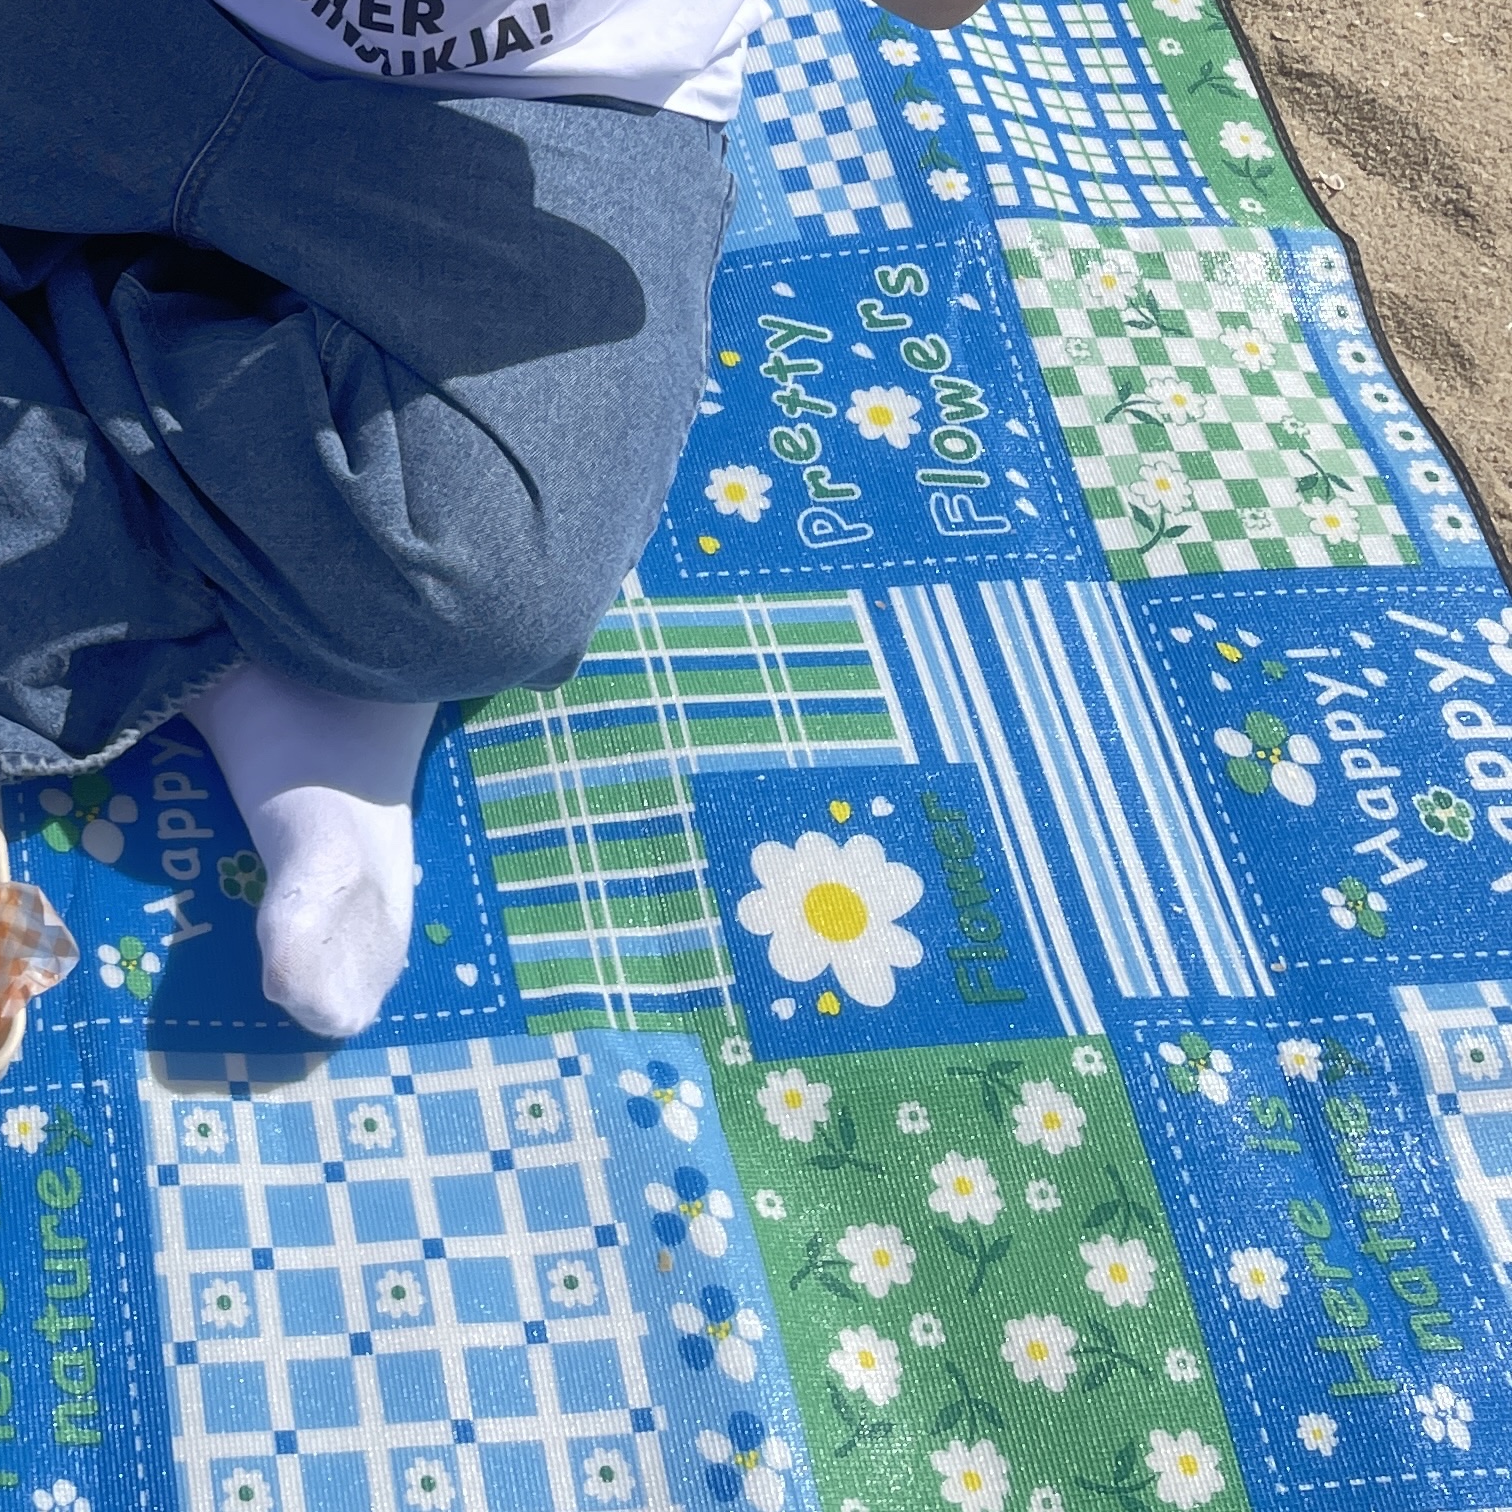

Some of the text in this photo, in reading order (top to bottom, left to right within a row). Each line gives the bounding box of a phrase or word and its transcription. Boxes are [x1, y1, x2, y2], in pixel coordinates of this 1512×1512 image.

[758, 313, 874, 550] Pretty
[851, 262, 1012, 538] Flowers
[142, 733, 215, 946] Happy
[1284, 648, 1428, 886] Happy!
[920, 791, 1027, 1008] Flower
[33, 1165, 102, 1446] nature
[1244, 1093, 1398, 1398] Here is
[1323, 1091, 1464, 1354] nature
